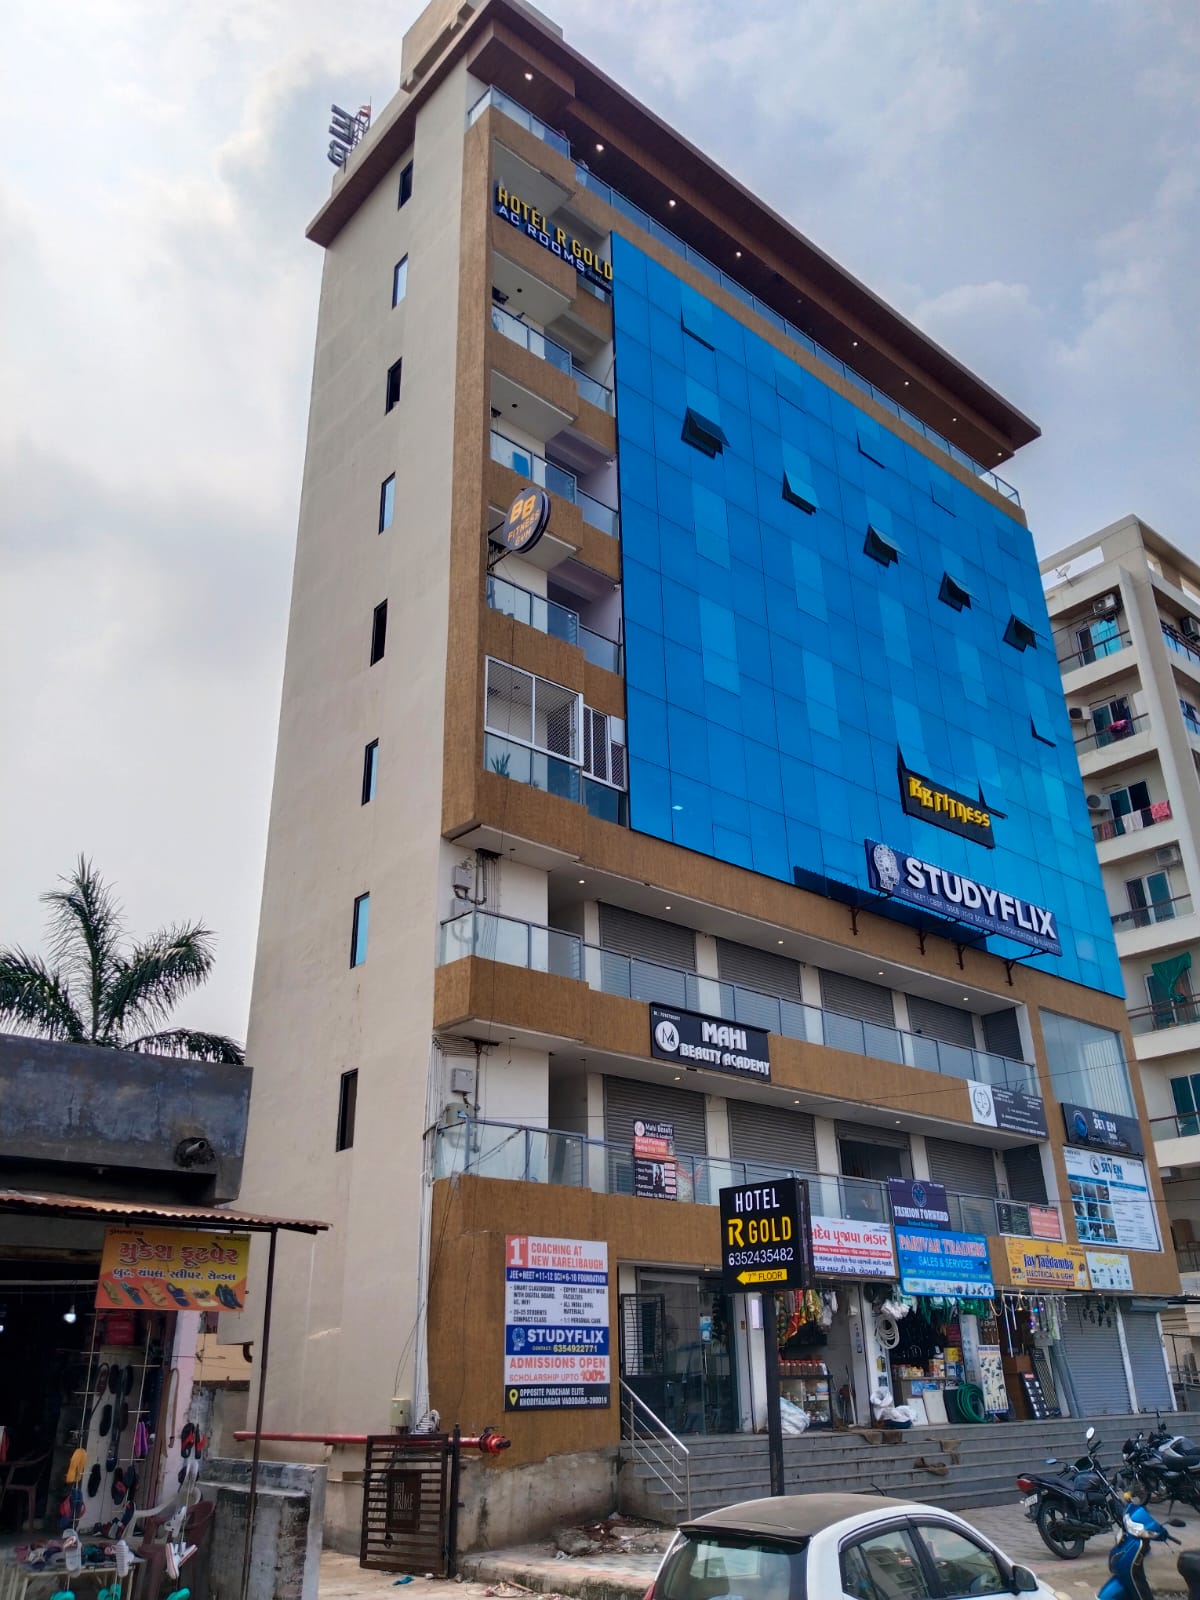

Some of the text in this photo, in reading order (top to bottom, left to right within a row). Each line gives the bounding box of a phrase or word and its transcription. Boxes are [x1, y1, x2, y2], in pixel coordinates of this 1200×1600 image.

[498, 186, 613, 280] HOTEL R GOLD
[499, 206, 585, 272] AC ROOMS
[905, 857, 1056, 940] STUDYFLIX
[701, 1021, 747, 1051] MAHI
[680, 1043, 770, 1075] BEAUTY ACADEMY
[735, 1187, 780, 1213] HOTEL
[727, 1215, 792, 1248] R GOLD
[119, 1237, 238, 1268] મુકેશ ફૂટવેર
[531, 1243, 582, 1257] COACHING AT
[898, 1234, 941, 1253] PARIVAR
[942, 1238, 986, 1257] TRADERS
[531, 1256, 603, 1269] NEW KARELIBAUGH
[728, 1247, 793, 1266] 6352435482
[918, 1256, 974, 1269] SALES & SERVICES
[510, 1270, 519, 1279] JEE
[758, 1271, 783, 1280] FLOOR
[1026, 1269, 1055, 1279] ELECTRICAL
[527, 1329, 604, 1344] STUDYFLIX
[553, 1344, 597, 1353] 6354922771
[510, 1357, 606, 1369] ADMISSIONS OPEN
[509, 1373, 557, 1382] SCHOLARSHIP
[561, 1373, 579, 1381] UPTO
[520, 1387, 584, 1397] OPPOSITE PANCHAM ELITE
